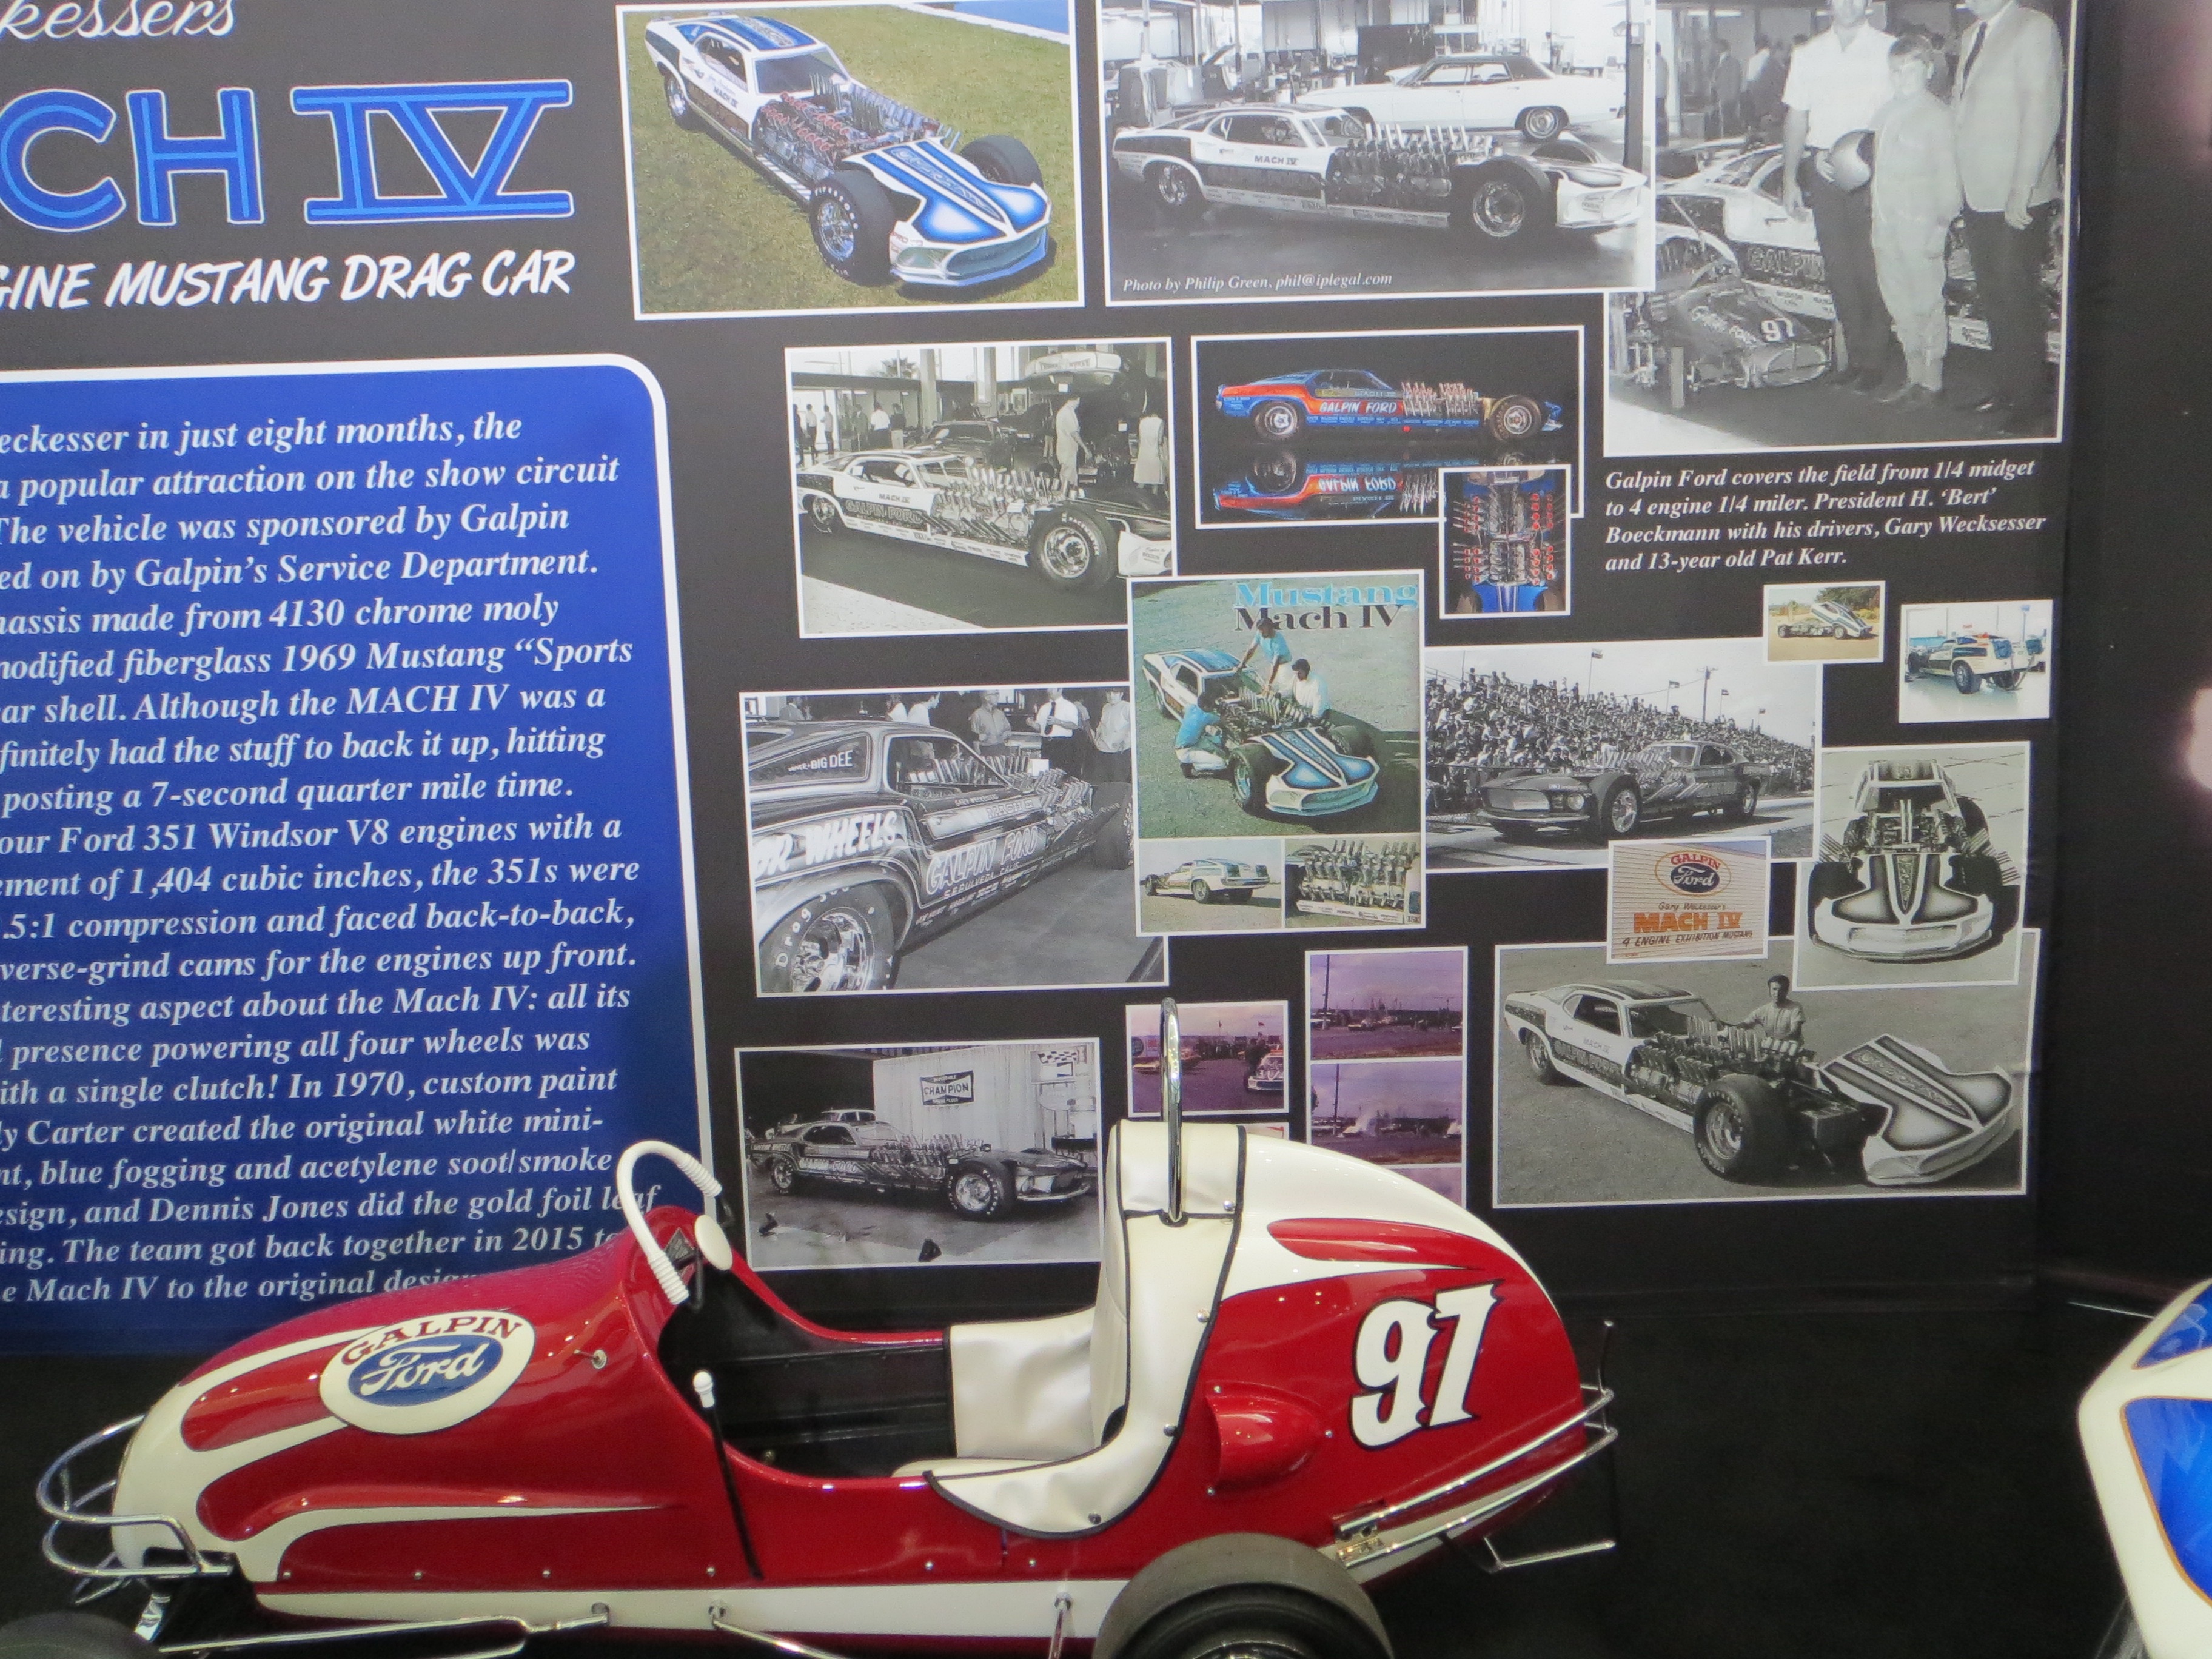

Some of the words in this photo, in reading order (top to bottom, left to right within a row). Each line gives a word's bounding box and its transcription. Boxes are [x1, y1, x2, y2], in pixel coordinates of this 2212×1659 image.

[0, 88, 264, 233] CH
[290, 79, 574, 224] IV
[1255, 155, 1284, 164] MACH
[104, 256, 330, 307] MUSTANG
[340, 252, 473, 301] DRAG
[482, 249, 576, 297] CAR
[1123, 278, 1161, 292] Photo
[1165, 277, 1182, 294] by
[1185, 276, 1224, 293] Philip
[1228, 275, 1273, 289] Green,
[1275, 273, 1392, 291] phil@iplegal.com
[1319, 401, 1360, 413] GALPIN
[1366, 401, 1397, 413] FORD
[0, 425, 129, 453] eckesser
[139, 423, 167, 449] in
[175, 421, 237, 456] just
[247, 418, 326, 452] eight
[337, 414, 466, 444] months,
[474, 412, 522, 440] the
[18, 469, 144, 506] popular
[153, 465, 304, 495] attraction
[317, 471, 354, 490] on
[367, 461, 414, 488] the
[426, 459, 505, 487] show
[517, 455, 619, 484] circuit
[1606, 471, 1672, 492] Galpin
[1678, 468, 1728, 487] Ford
[1732, 472, 1792, 485] covers
[1798, 466, 1828, 483] the
[1831, 464, 1874, 486] field
[1879, 463, 1929, 484] from
[1934, 461, 1965, 478] 1/4
[1969, 459, 2035, 480] midget
[846, 500, 886, 517] GALPIN
[1606, 501, 1624, 516] to
[1629, 498, 1642, 515] 4
[1647, 497, 1712, 518] engine
[1718, 495, 1748, 513] 1/4
[1753, 494, 1808, 511] miler.
[1814, 491, 1905, 509] President
[1909, 489, 1933, 506] H.
[1605, 525, 1720, 543] Boeckmann
[1728, 522, 1767, 540] with
[1773, 521, 1802, 538] his
[1807, 520, 1879, 538] drivers,
[1885, 518, 1932, 538] Gary
[1939, 514, 2046, 532] Wecksesser
[0, 562, 31, 589] ed
[41, 570, 78, 588] on
[92, 560, 125, 594] by
[136, 557, 267, 592] Galpin’s
[278, 554, 390, 582] Service
[401, 551, 597, 585] Department.
[1605, 553, 1643, 571] and
[1648, 552, 1721, 573] 13-year
[1725, 549, 1756, 567] old
[1760, 549, 1793, 566] Pat
[1797, 548, 1846, 565] Kerr.
[1233, 581, 1418, 608] Mustang
[1235, 606, 1350, 631] Mach
[1359, 605, 1404, 628] IV
[118, 647, 270, 683] fiberglass
[283, 644, 355, 671] 1969
[366, 643, 505, 672] Mustang
[515, 638, 632, 671] “Sports
[0, 740, 99, 774] finitely
[110, 737, 166, 764] had
[175, 737, 219, 763] the
[230, 734, 300, 767] stuff
[305, 737, 332, 759] to
[343, 731, 413, 758] back
[422, 730, 442, 756] it
[452, 737, 500, 763] up,
[508, 726, 606, 760] hitting
[830, 750, 853, 768] DEE
[805, 811, 897, 866] WHEELS
[926, 839, 996, 895] GALPIN
[1001, 826, 1038, 865] FORD
[1671, 853, 1720, 870] GALPIN
[1673, 866, 1714, 886] Ford
[0, 873, 81, 897] ment
[90, 868, 123, 901] of
[130, 866, 211, 899] 1,404
[222, 865, 303, 891] cubic
[313, 862, 423, 893] inches,
[432, 859, 478, 886] the
[488, 858, 558, 885] 351s
[569, 863, 640, 882] were
[944, 872, 994, 897] SEPULVEDA
[1634, 911, 1709, 933] MACH
[1717, 911, 1743, 929] IV
[1658, 902, 1679, 911] Gary
[1622, 937, 1630, 947] 4
[1635, 935, 1671, 946] ENGINE
[1675, 932, 1720, 943] EXHIBITION
[0, 952, 169, 985] verse-grind
[179, 958, 255, 976] cams
[261, 950, 310, 981] for
[320, 948, 365, 973] the
[377, 946, 491, 977] engines
[504, 951, 540, 974] up
[546, 942, 635, 974] front.
[1, 1080, 38, 1104] ith
[49, 1087, 66, 1103] a
[76, 1077, 163, 1108] single
[173, 1074, 278, 1101] clutch!
[289, 1074, 321, 1098] In
[333, 1071, 414, 1100] 1970,
[424, 1073, 532, 1094] custom
[538, 1067, 617, 1098] paint
[923, 1083, 969, 1095] CHAMPION
[41, 1160, 103, 1185] blue
[109, 1158, 226, 1189] fogging
[236, 1155, 292, 1179] and
[300, 1153, 437, 1183] acetylene
[449, 1147, 612, 1174] soot/smoke
[27, 1278, 110, 1301] Mach
[122, 1276, 158, 1299] IV
[168, 1278, 195, 1299] to
[204, 1274, 248, 1298] the
[259, 1270, 374, 1301] original
[342, 1316, 523, 1366] GALPIN
[360, 1342, 490, 1396] Ford
[1347, 1278, 1505, 1451] 97
